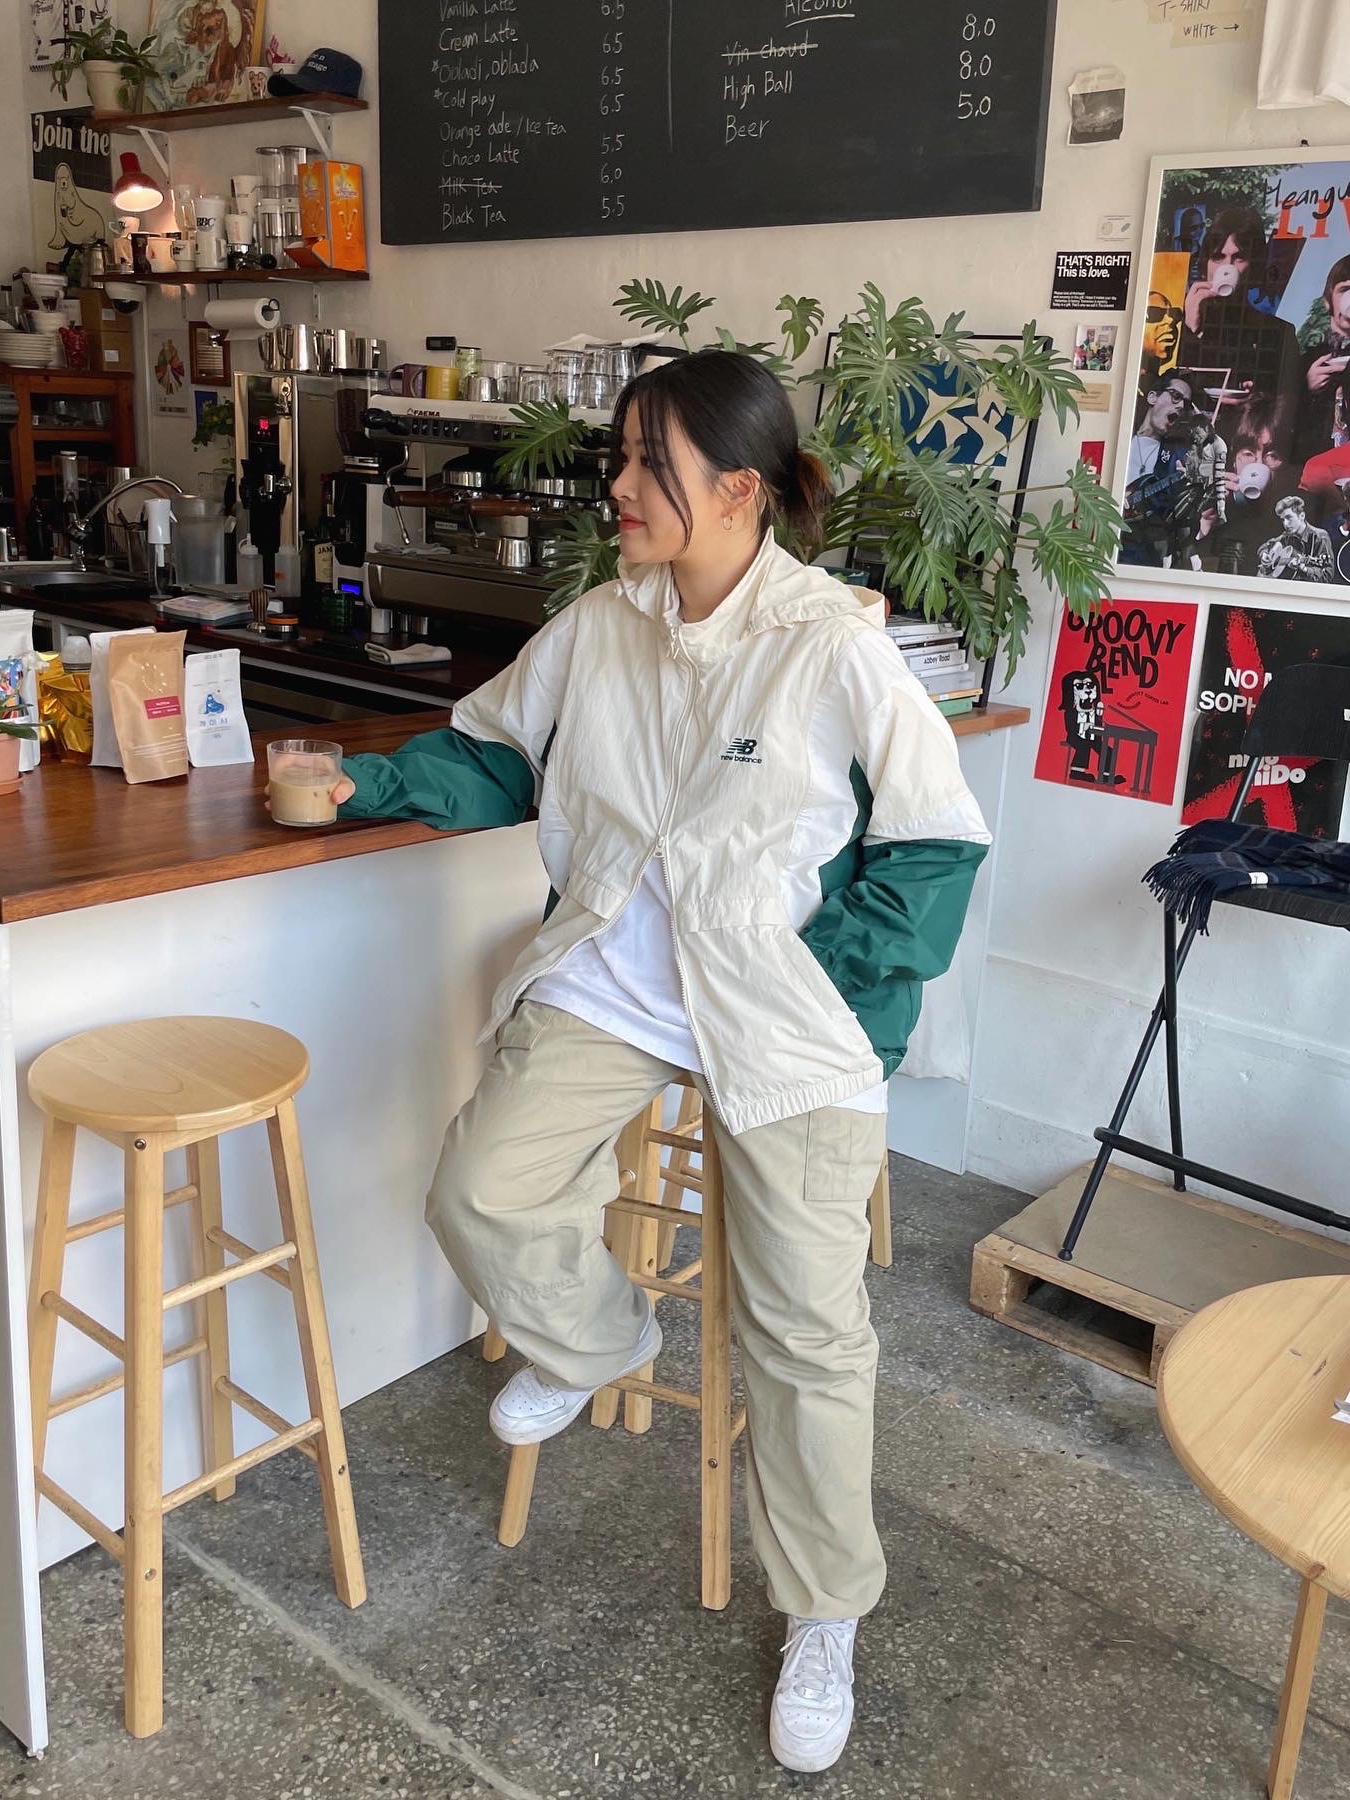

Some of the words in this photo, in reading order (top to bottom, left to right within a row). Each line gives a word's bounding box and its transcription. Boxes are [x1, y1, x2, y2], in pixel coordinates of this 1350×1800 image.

[439, 0, 479, 22] Vanilla
[484, 0, 518, 15] Latte
[785, 0, 852, 18] Alcoo
[439, 28, 479, 51] Cream
[484, 19, 519, 43] Latte
[1183, 23, 1217, 39] WHITE
[726, 41, 750, 66] Vin
[441, 88, 466, 108] Cold
[723, 75, 755, 111] High
[764, 70, 794, 97] Ball
[600, 93, 625, 116] 6.5
[34, 114, 73, 153] Join
[439, 121, 482, 149] Orange
[488, 112, 512, 136] ade
[725, 114, 772, 145] Beer
[442, 147, 481, 168] Choco
[488, 142, 520, 165] Latte
[600, 162, 623, 184] 6.0
[440, 175, 468, 196] Milk
[473, 177, 499, 198] Tea
[442, 203, 475, 231] Black
[481, 204, 507, 228] Tea
[1057, 266, 1077, 277] This
[1079, 266, 1087, 277] is
[1088, 266, 1110, 278] love.
[1058, 255, 1093, 266] THAT'S
[1095, 255, 1129, 266] RIGHT!
[413, 409, 440, 417] FAEMA
[1085, 642, 1159, 694] BLEND
[1224, 667, 1259, 690] NO
[734, 755, 762, 764] balance
